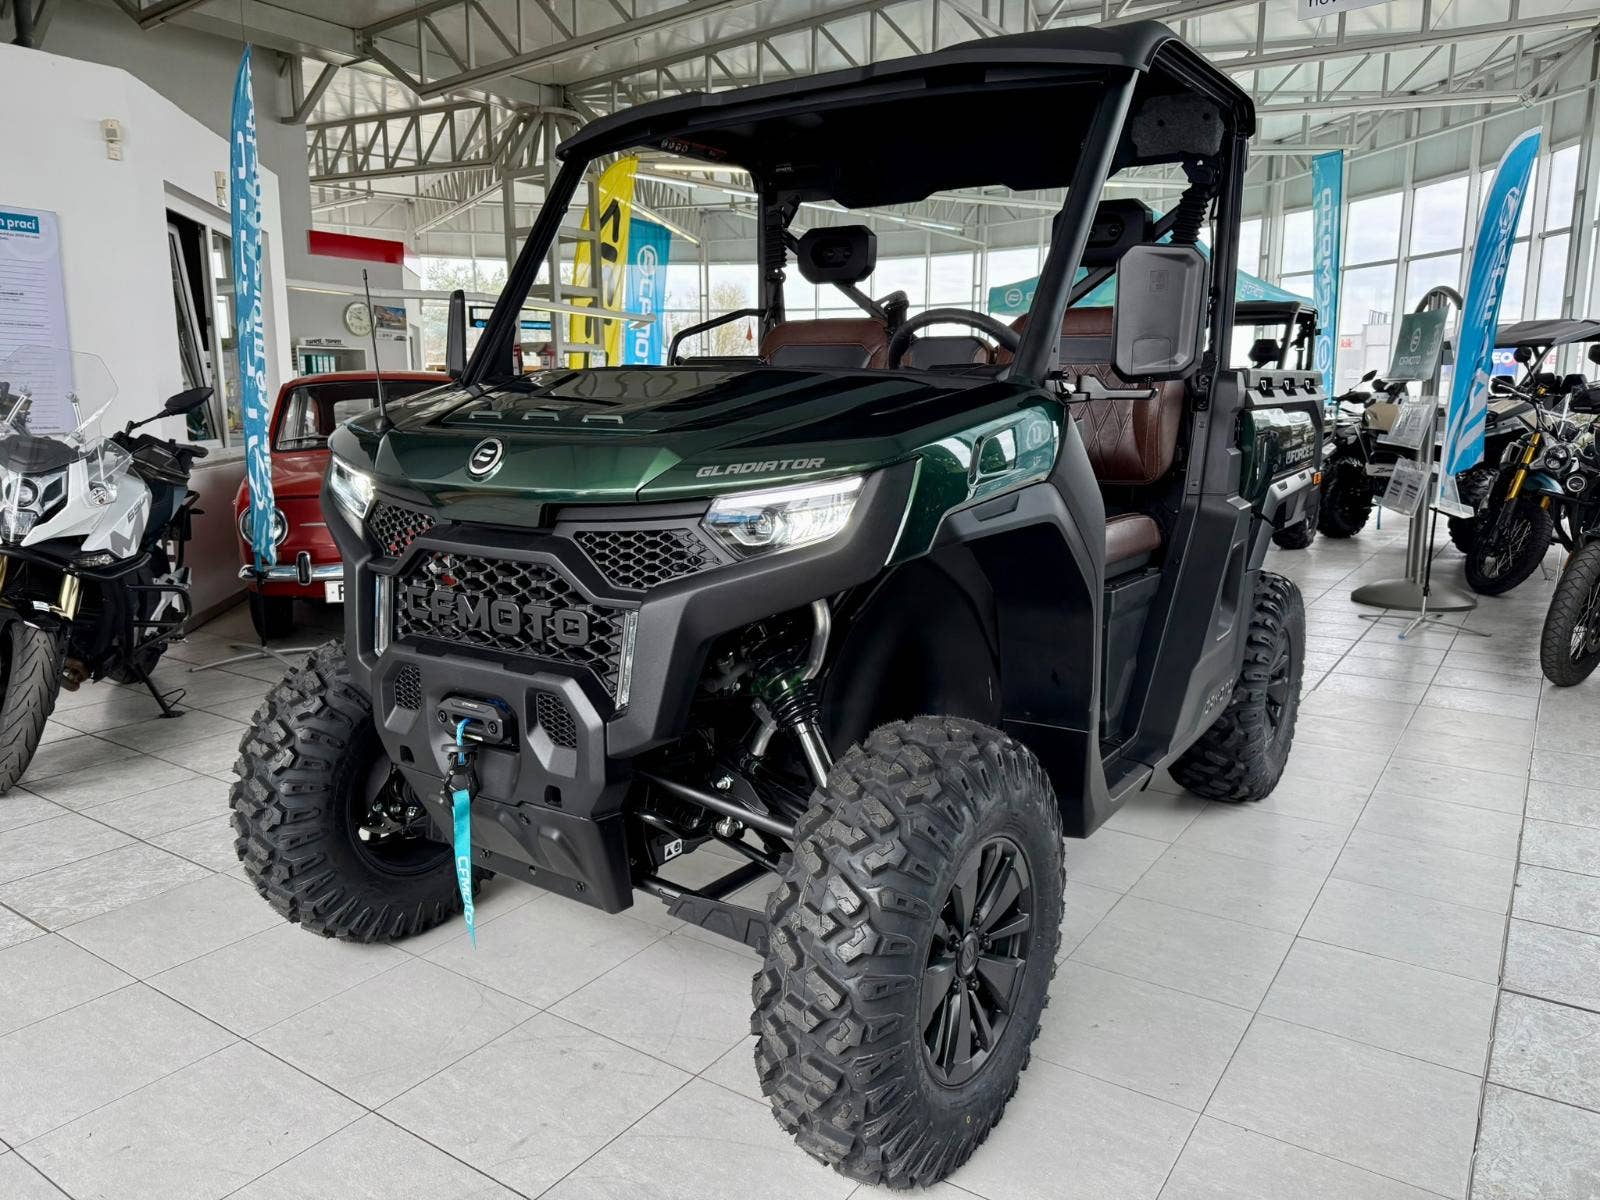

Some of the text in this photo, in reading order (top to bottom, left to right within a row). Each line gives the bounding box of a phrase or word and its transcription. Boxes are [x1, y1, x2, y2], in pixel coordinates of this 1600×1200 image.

[7, 219, 36, 230] prací
[696, 457, 825, 478] GLADIATOR
[406, 585, 589, 647] CFMOTO
[457, 855, 475, 926] CFMOTO
